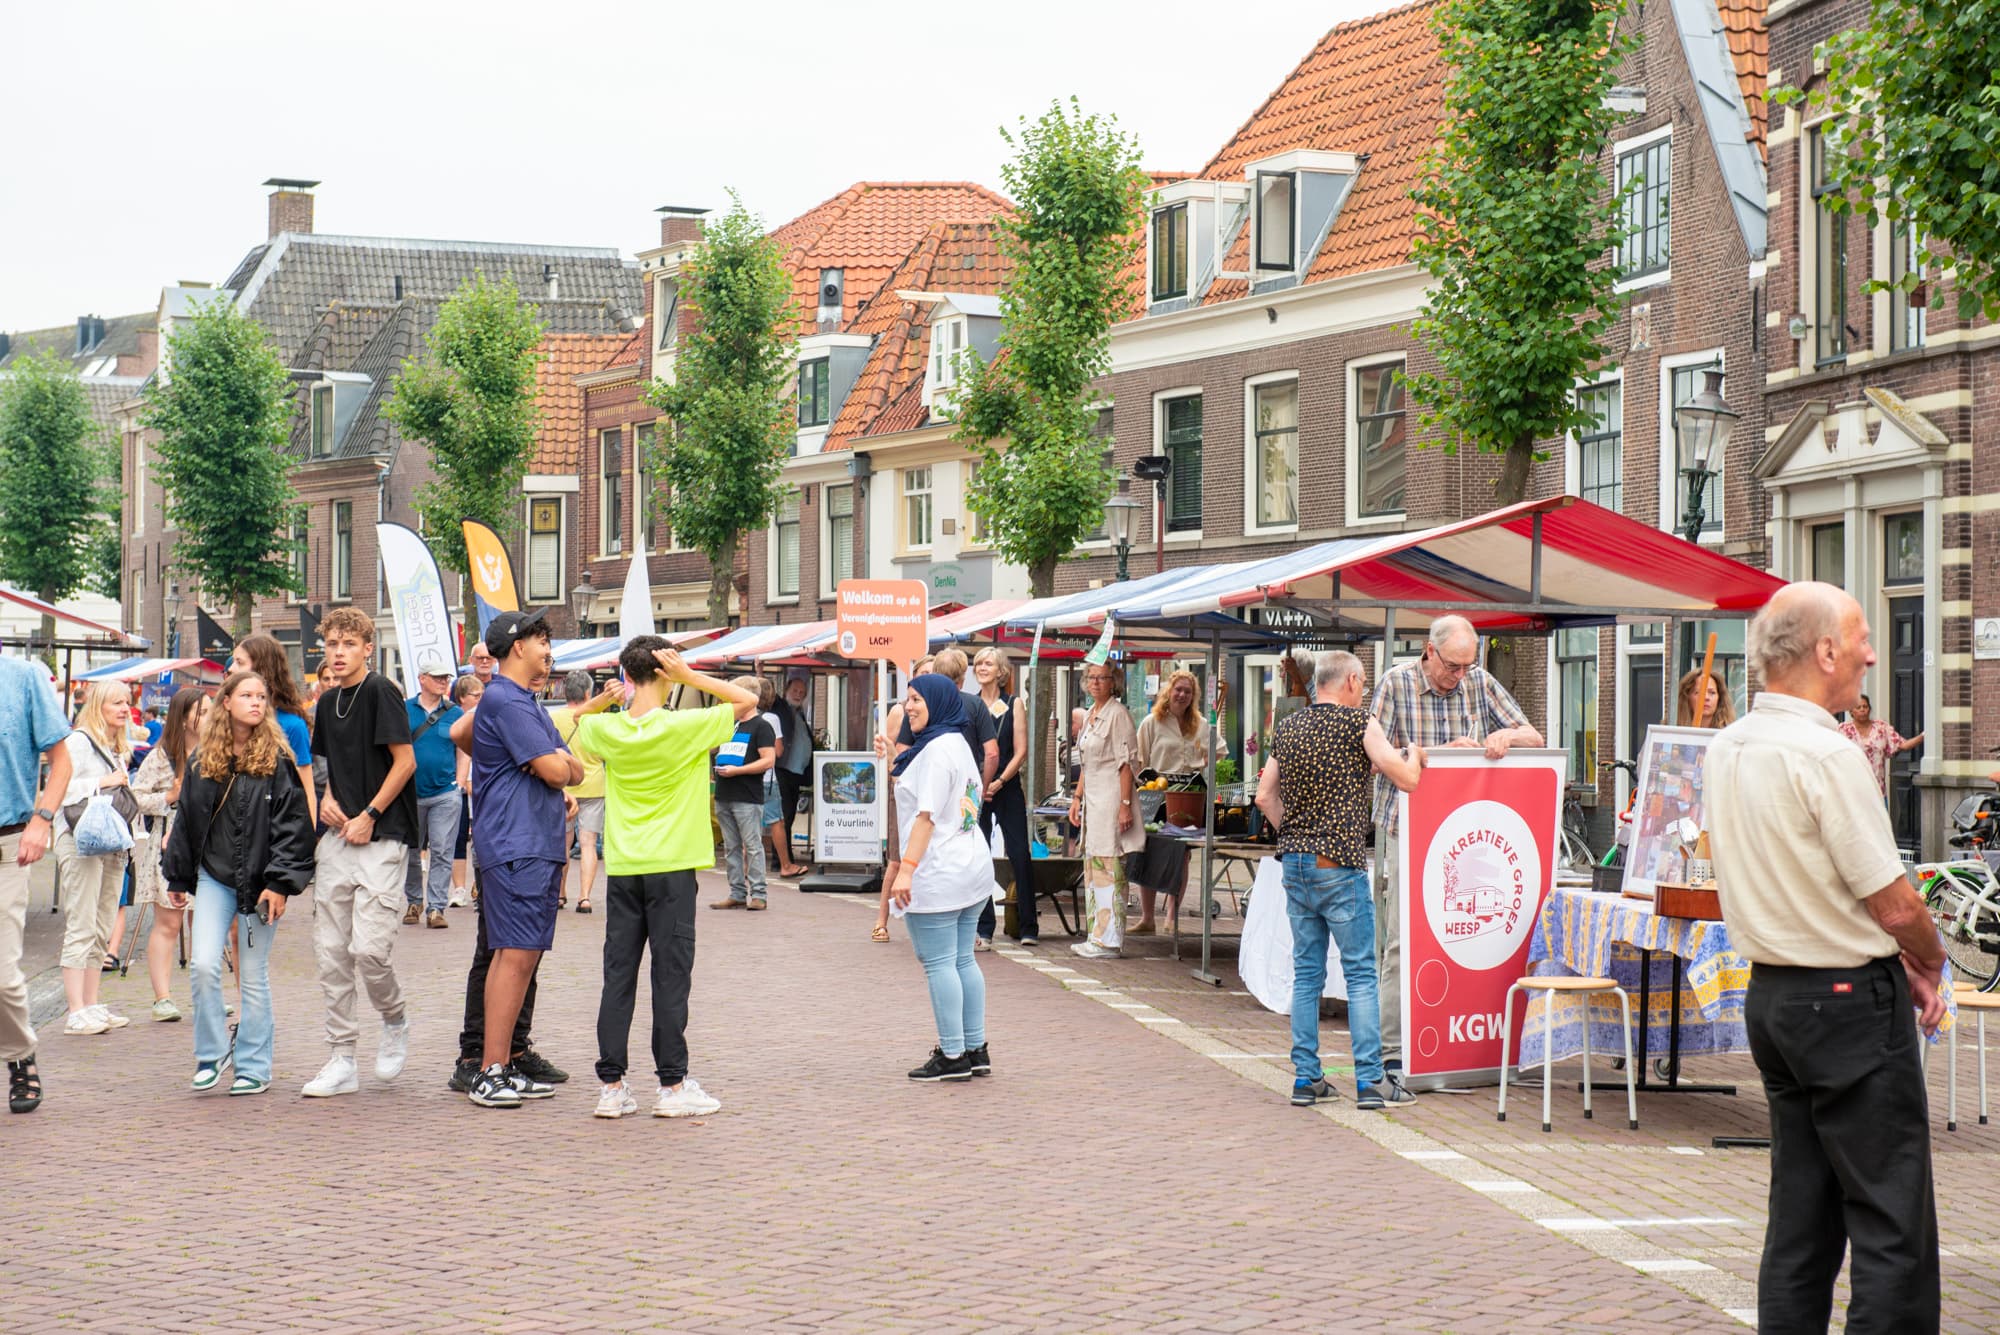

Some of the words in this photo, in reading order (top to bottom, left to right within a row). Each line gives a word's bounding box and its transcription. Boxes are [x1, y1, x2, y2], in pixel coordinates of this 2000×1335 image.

[842, 590, 894, 605] Welkom
[896, 597, 907, 608] op
[909, 595, 921, 605] de
[841, 612, 922, 626] Verenigingenmarkt
[825, 818, 835, 827] de
[837, 818, 874, 827] Vuurlinie
[1448, 829, 1518, 866] KREATIEVE
[1504, 868, 1524, 935] GROEP
[1445, 921, 1481, 935] WEESP
[1448, 1012, 1506, 1043] KGW
